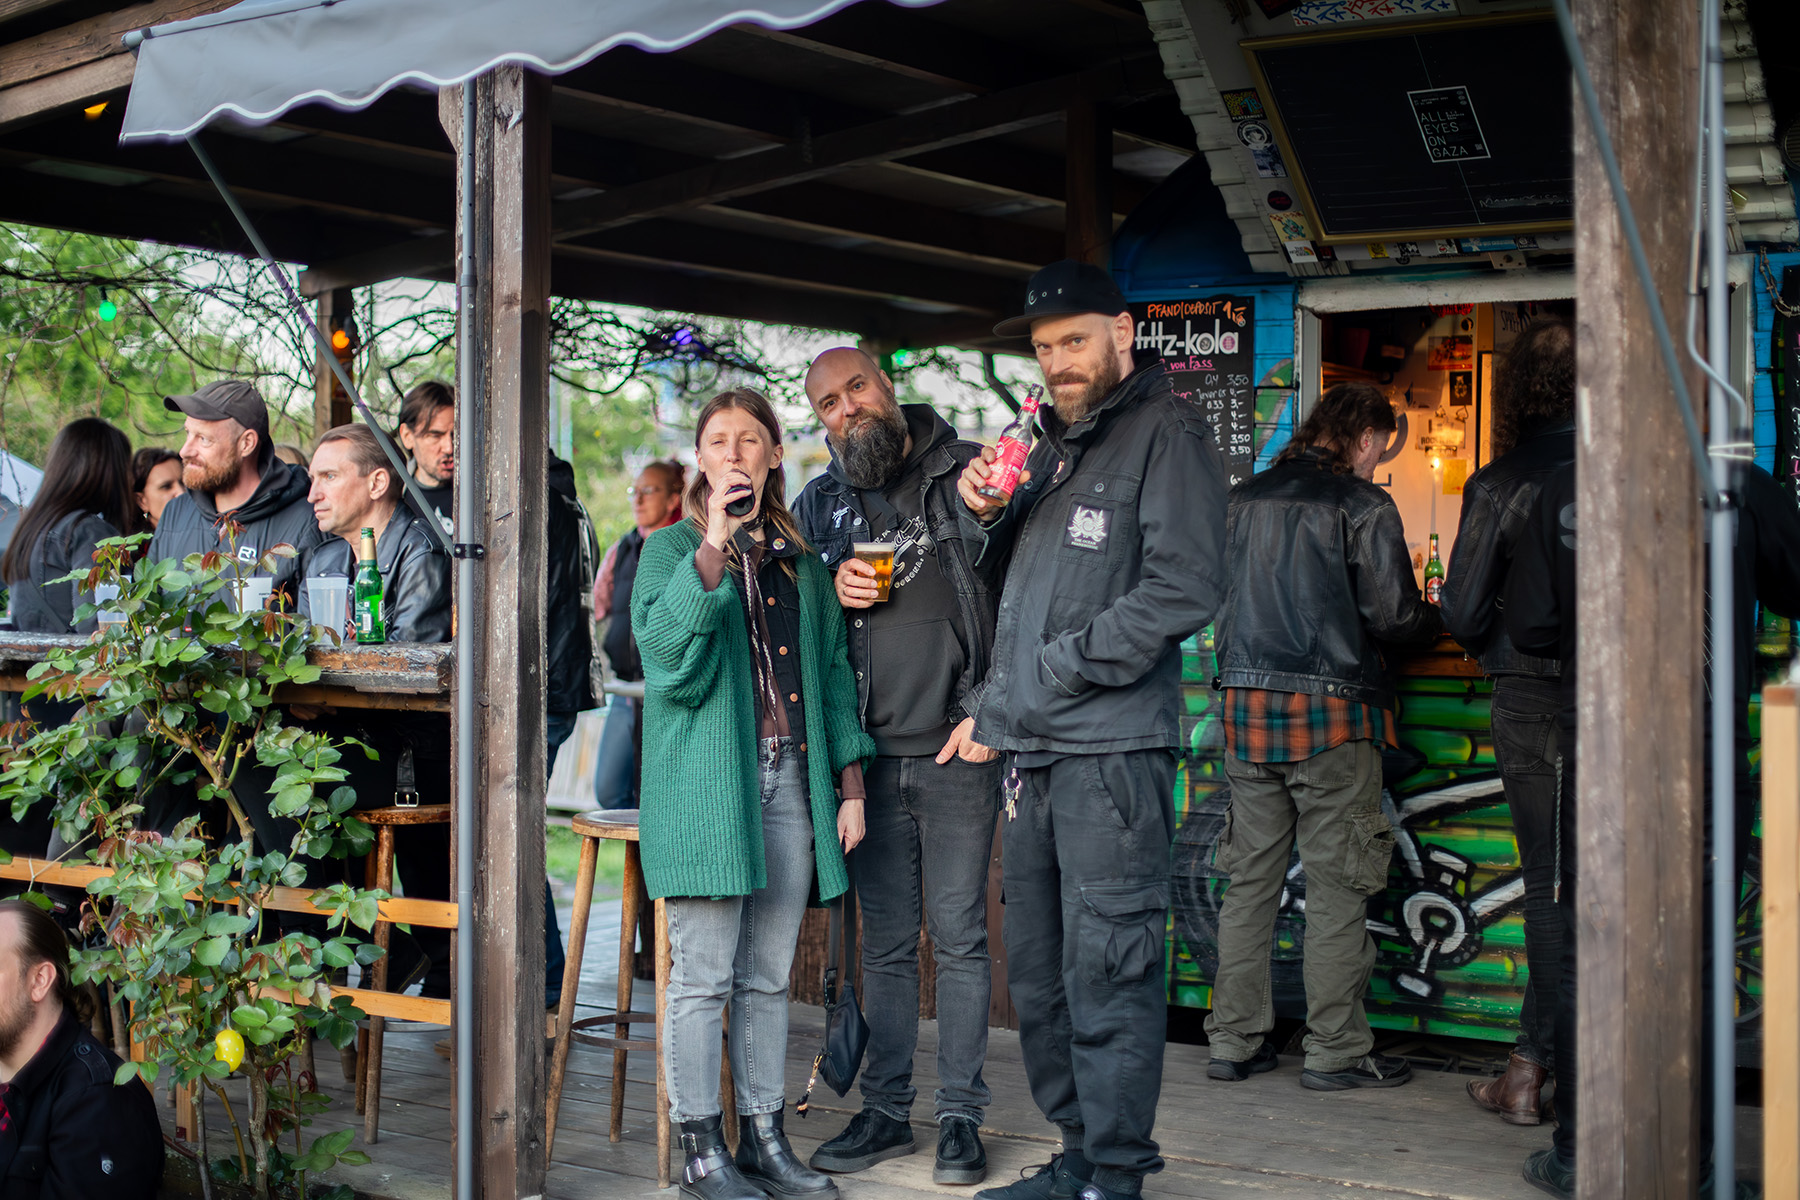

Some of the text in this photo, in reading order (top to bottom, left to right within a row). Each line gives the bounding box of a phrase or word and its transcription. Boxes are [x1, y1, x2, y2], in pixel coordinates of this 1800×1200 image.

[1421, 111, 1446, 123] ALL
[1424, 122, 1459, 135] EYES
[1428, 136, 1447, 147] ON
[1432, 146, 1469, 158] GAZA
